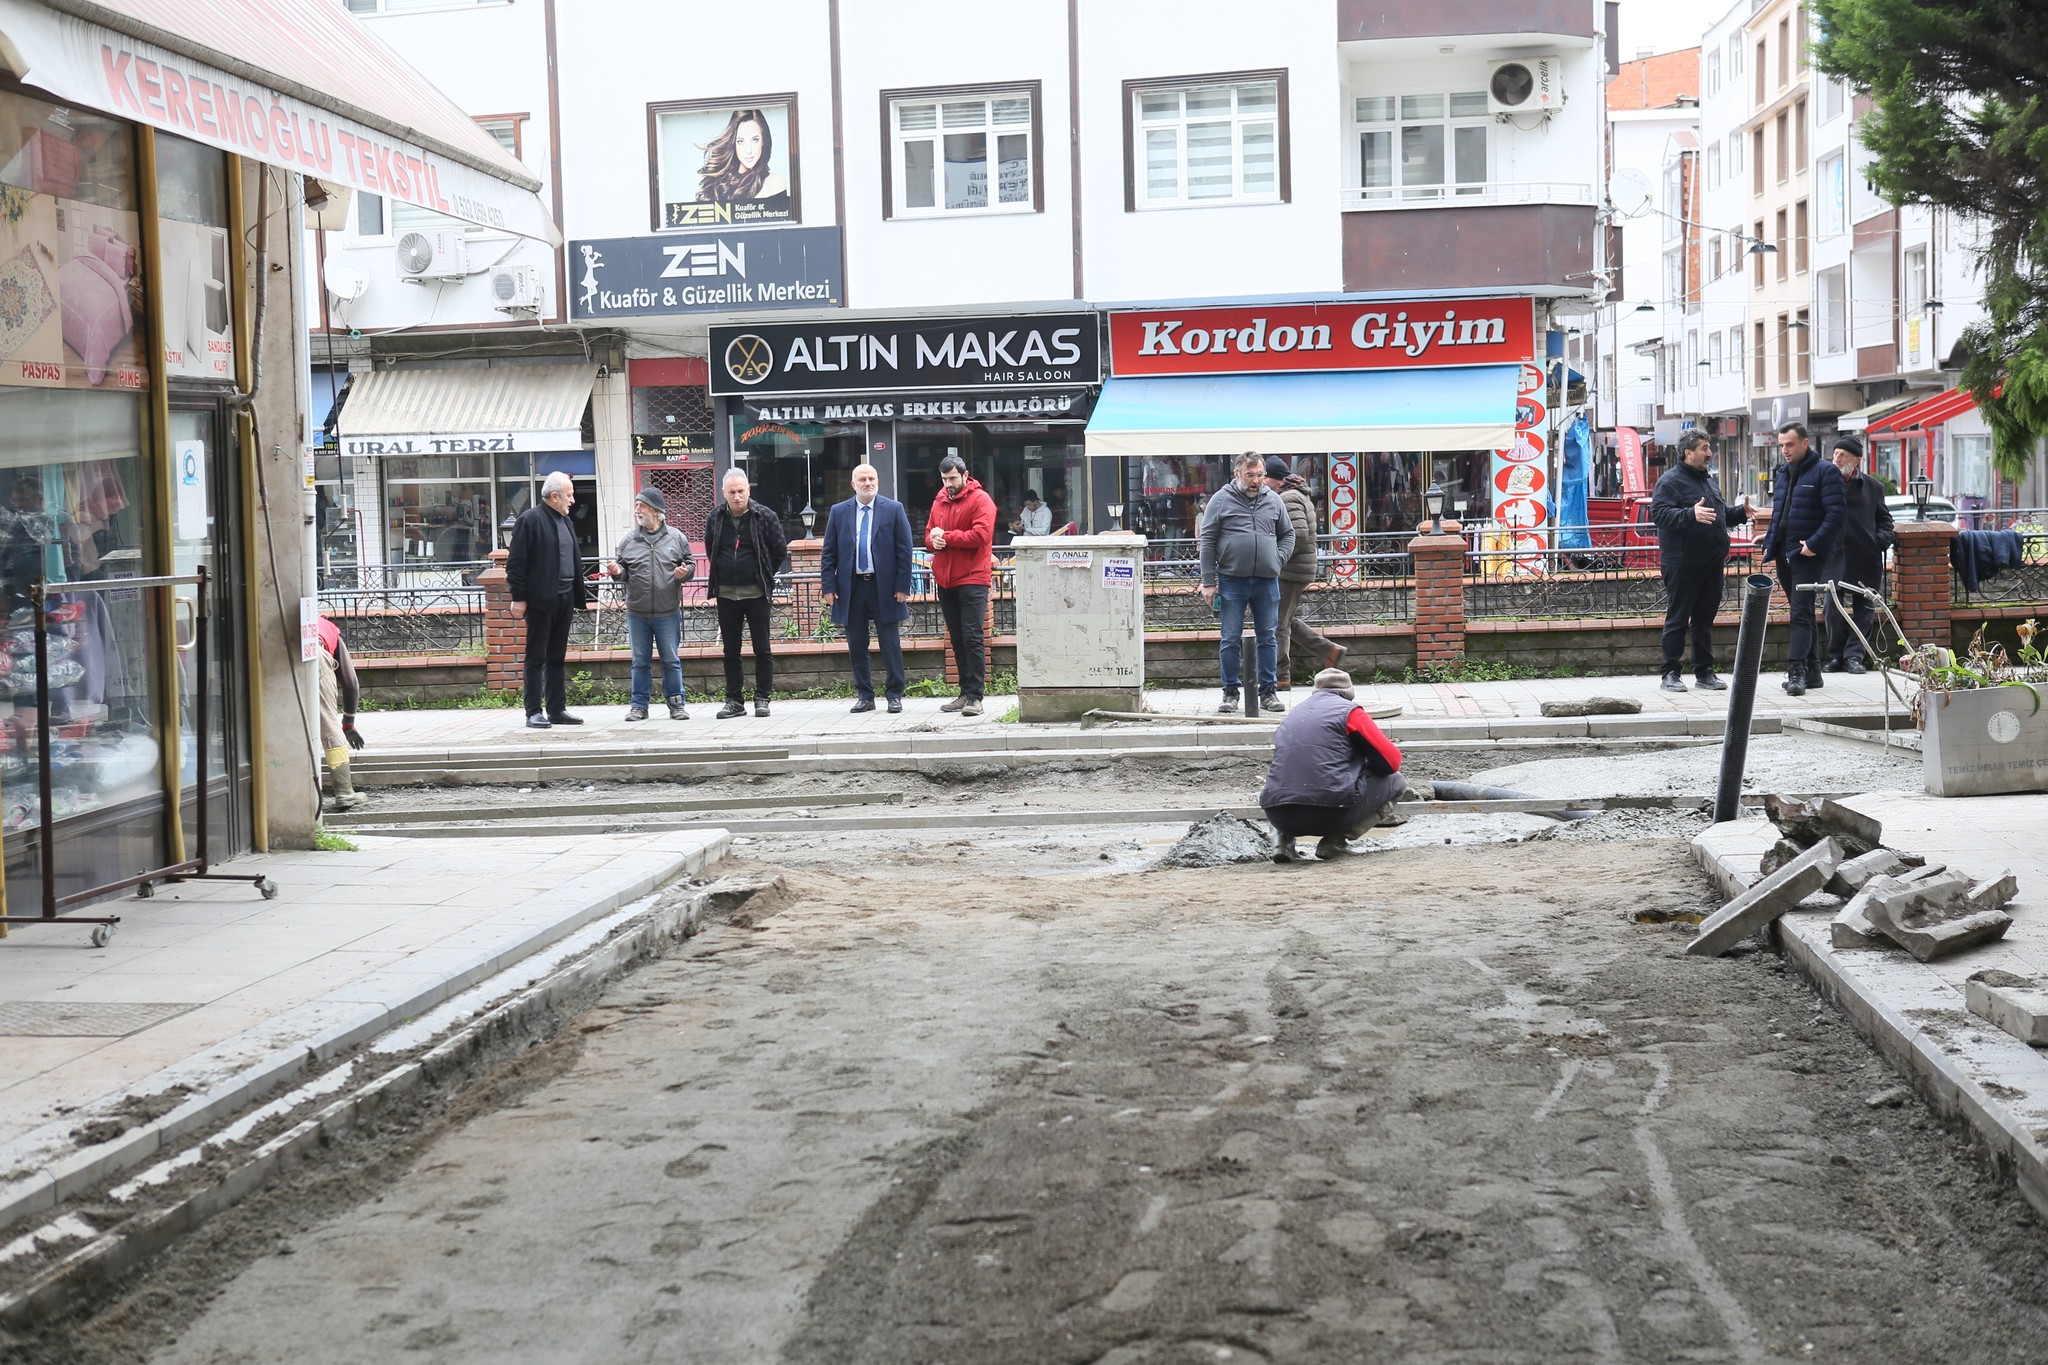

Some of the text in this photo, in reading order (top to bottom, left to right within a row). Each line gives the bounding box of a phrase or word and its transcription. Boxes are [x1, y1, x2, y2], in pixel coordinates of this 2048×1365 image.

[1539, 59, 1550, 93] arçelik
[102, 44, 334, 175] KEREMOĞLU
[337, 128, 450, 213] TEKSTİL
[679, 201, 732, 225] ZEN
[734, 204, 757, 212] Kuaför
[762, 210, 789, 219] Merkezi
[660, 238, 746, 279] ZEN
[600, 279, 830, 309] Kuaför & Güzellik Merkezi
[1138, 310, 1506, 357] Kordon Giyim
[916, 328, 1081, 370] MAKAS
[22, 361, 61, 381] PASPAS
[984, 370, 1071, 381] HAIR SALOON
[758, 395, 1071, 421] ALTIN MAKAS ERKEK KUAFÖRÜ
[348, 433, 515, 455] URAL TERZİ
[661, 436, 688, 447] ZEN
[1948, 764, 1975, 774] TEMİZ
[1977, 762, 2005, 772] İNSAN
[2007, 759, 2034, 769] TEMİZ
